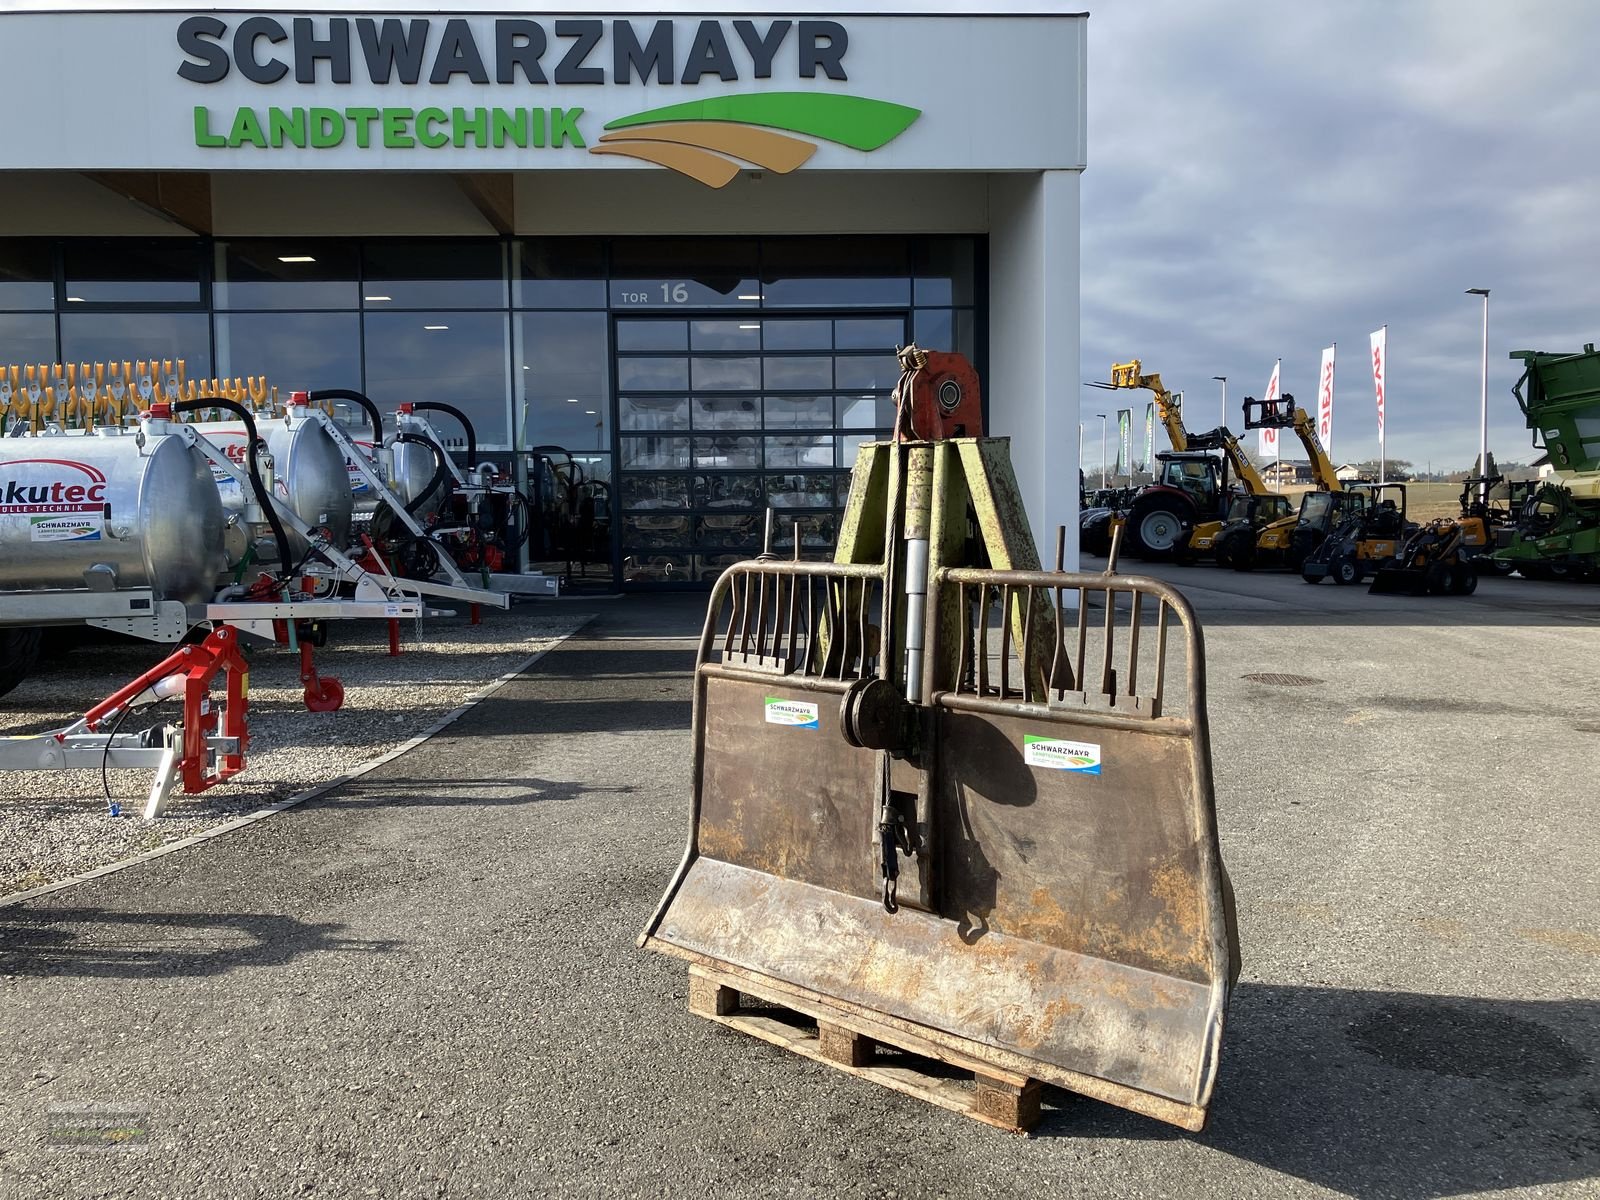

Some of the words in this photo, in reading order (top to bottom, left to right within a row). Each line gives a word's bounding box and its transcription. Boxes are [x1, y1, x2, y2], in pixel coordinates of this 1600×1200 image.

[176, 16, 849, 87] SCHWARZMAYR
[193, 106, 587, 149] LANDTECHNIK
[621, 293, 648, 303] TOR
[661, 283, 689, 303] 16
[1311, 431, 1324, 453] JCB
[1234, 447, 1249, 467] JCB
[0, 481, 106, 504] kutec
[37, 521, 91, 529] SCHWARZMAYR
[770, 703, 811, 714] SCHWARZMAYR
[1031, 743, 1090, 757] SCHWARZMAYR
